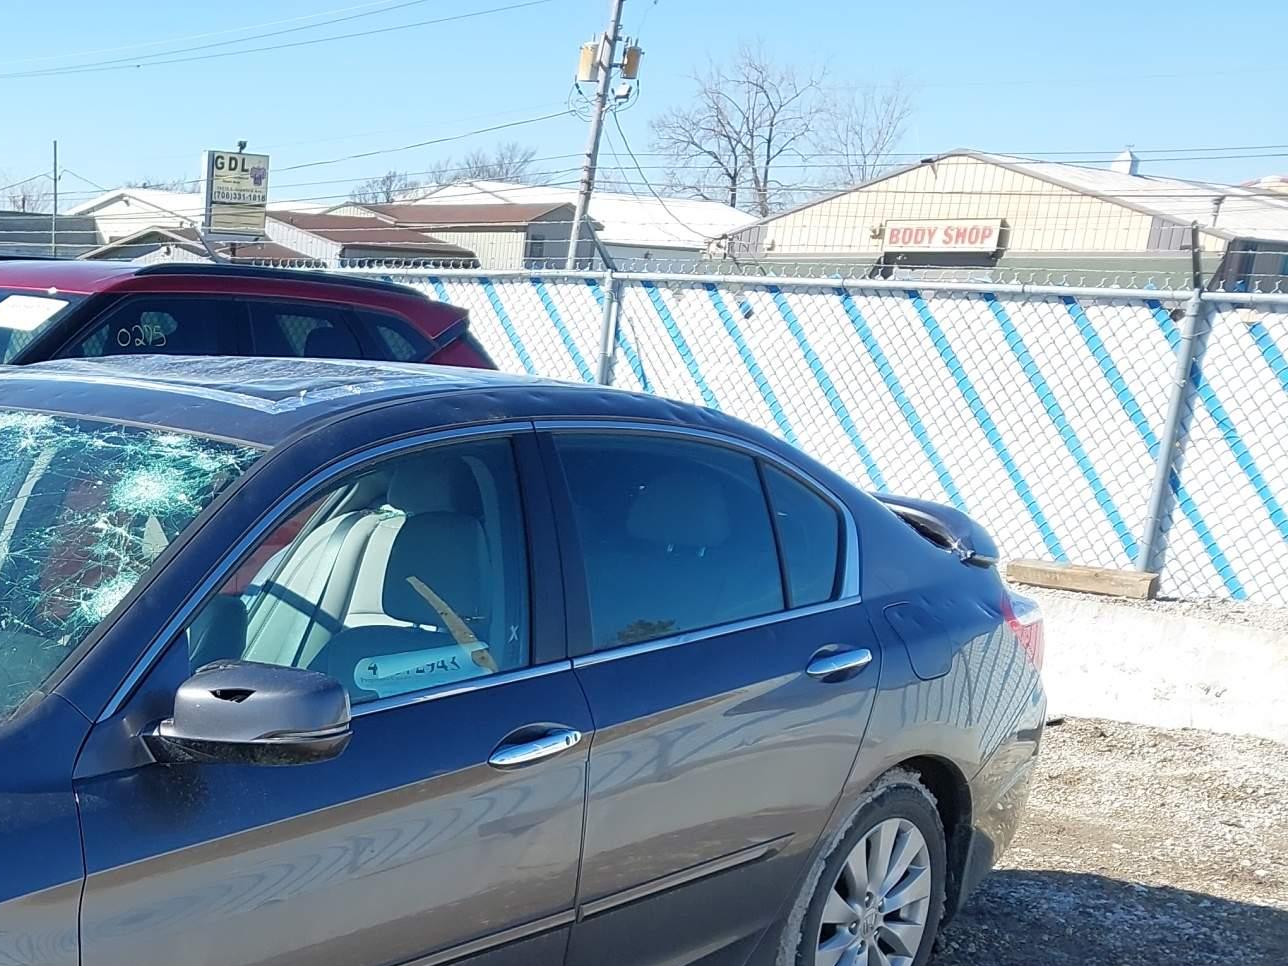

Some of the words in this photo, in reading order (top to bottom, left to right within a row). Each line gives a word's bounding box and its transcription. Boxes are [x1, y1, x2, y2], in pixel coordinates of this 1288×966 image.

[214, 155, 250, 173] GDL
[888, 227, 938, 245] BODY
[941, 224, 995, 245] SHOP
